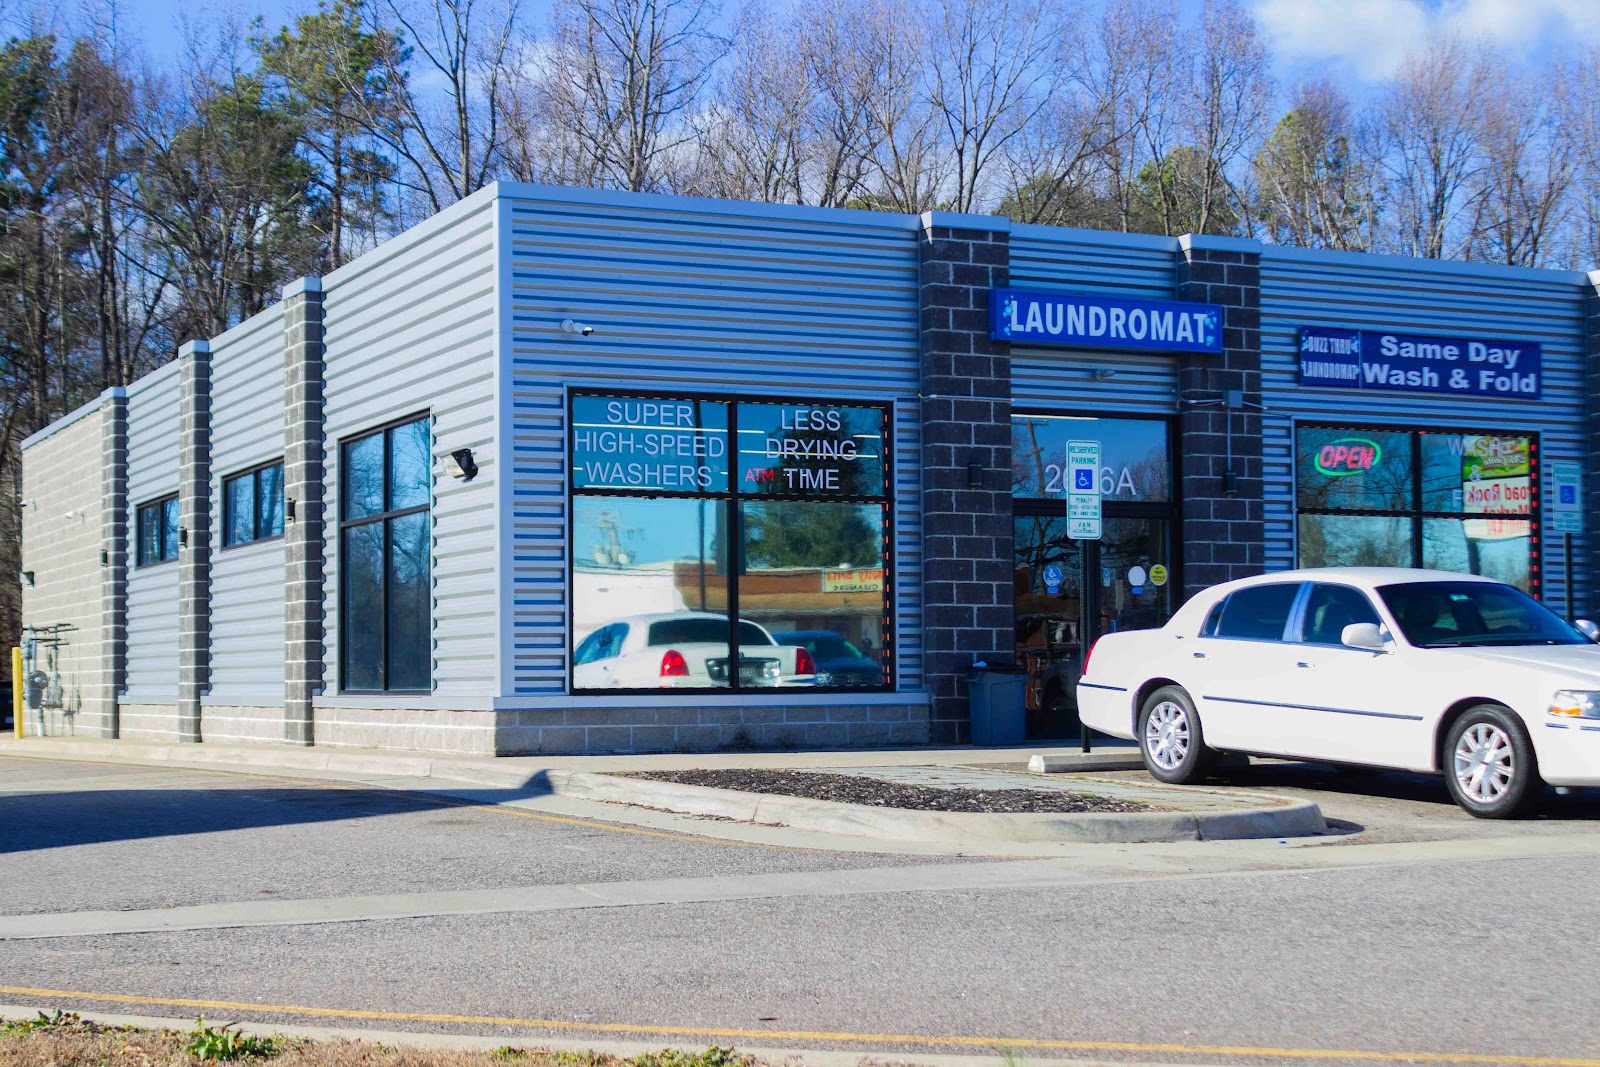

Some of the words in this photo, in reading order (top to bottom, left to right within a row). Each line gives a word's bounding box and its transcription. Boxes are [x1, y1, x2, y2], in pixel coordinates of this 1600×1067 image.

[1010, 300, 1208, 343] LAUNDROMAT
[1380, 335, 1460, 361] Same
[1468, 342, 1521, 370] Day
[1303, 360, 1357, 380] LAUNDROMAT
[1362, 363, 1440, 388] Wash
[1448, 368, 1471, 389] &
[1479, 370, 1537, 393] Fold
[606, 400, 694, 427] SUPER
[780, 409, 841, 432] LESS
[574, 430, 725, 458] HIGH-SPEED
[766, 438, 857, 461] DRYING
[1070, 445, 1098, 454] RESERVED
[1447, 437, 1501, 458] WASH
[1071, 456, 1097, 465] PARKING
[1319, 445, 1376, 470] OPEN
[585, 461, 713, 487] WASHERS
[744, 468, 775, 482] ATM
[785, 468, 840, 490] TIME
[1469, 464, 1481, 482] &
